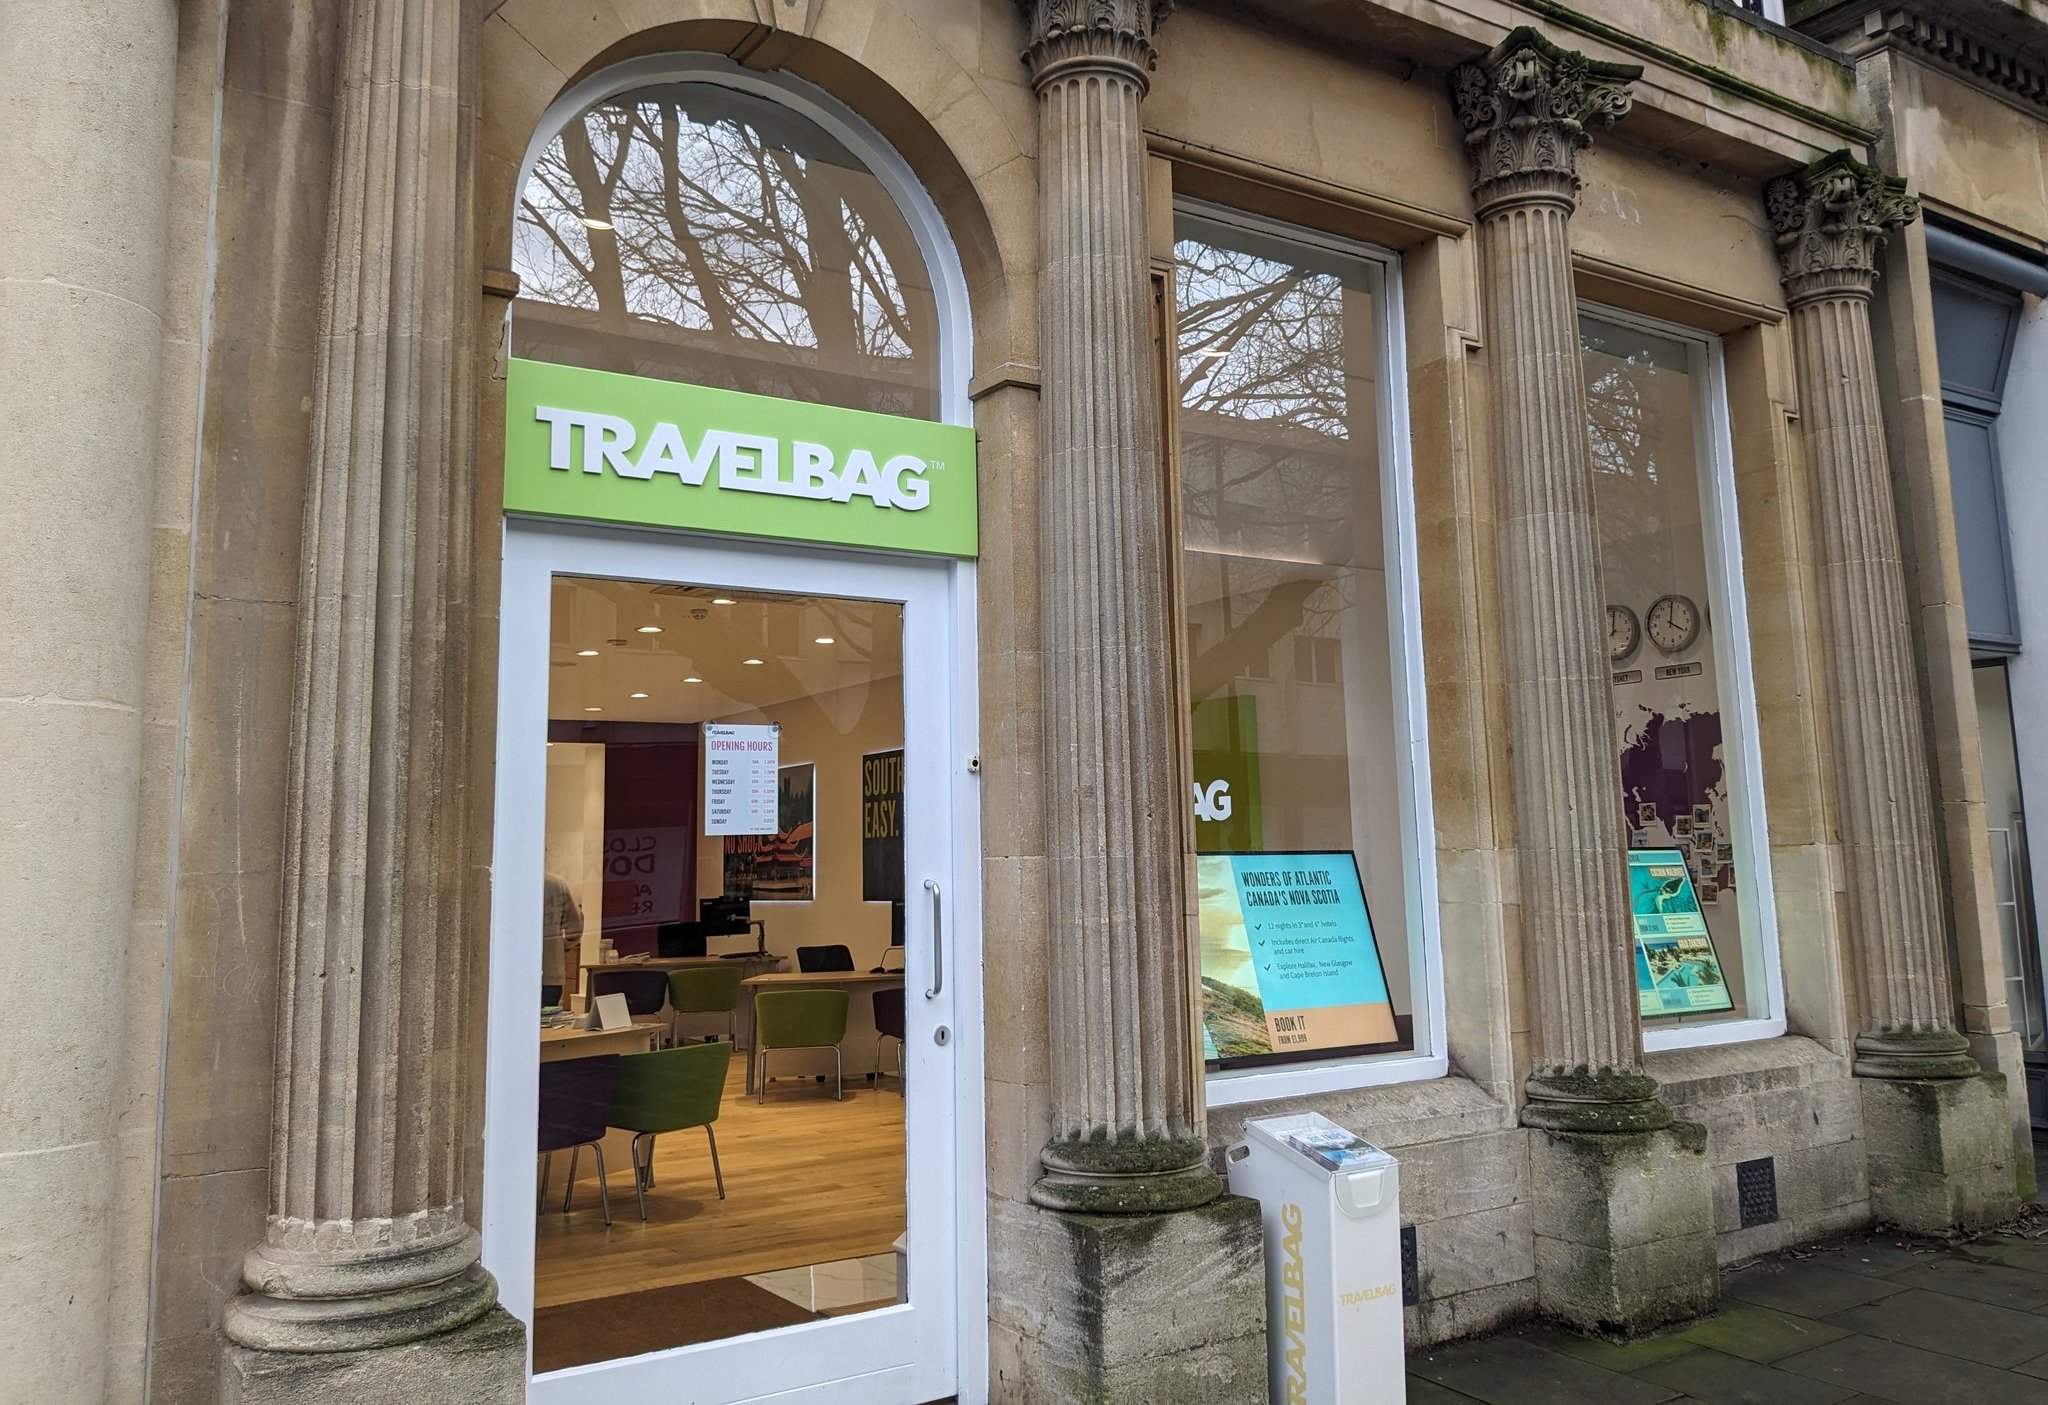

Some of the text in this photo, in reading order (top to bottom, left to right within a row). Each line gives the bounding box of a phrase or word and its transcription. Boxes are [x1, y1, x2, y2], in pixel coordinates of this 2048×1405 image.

[535, 405, 930, 512] TRAVELBAG
[1666, 666, 1691, 676] NEW YORK
[711, 740, 773, 752] OPENING HOURS
[865, 756, 904, 796] SOUTH
[865, 800, 899, 838] EASY.
[1241, 870, 1331, 887] WONDERS OF ATLANTIC
[1246, 889, 1341, 907] CANADA'S NOVA SCOTIA
[1275, 922, 1292, 931] nights
[1318, 936, 1338, 944] Canada
[1338, 935, 1354, 943] flights
[1277, 962, 1297, 971] Explore
[1331, 960, 1352, 968] Glasgow
[1290, 971, 1304, 980] Cape
[1305, 970, 1322, 978] Breton
[1323, 969, 1339, 977] Island
[1274, 1015, 1305, 1032] BOOK IT
[1278, 1035, 1291, 1044] FROM
[1340, 1283, 1397, 1306] TRAVELBAG
[1282, 1203, 1307, 1405] RAVELBAG
